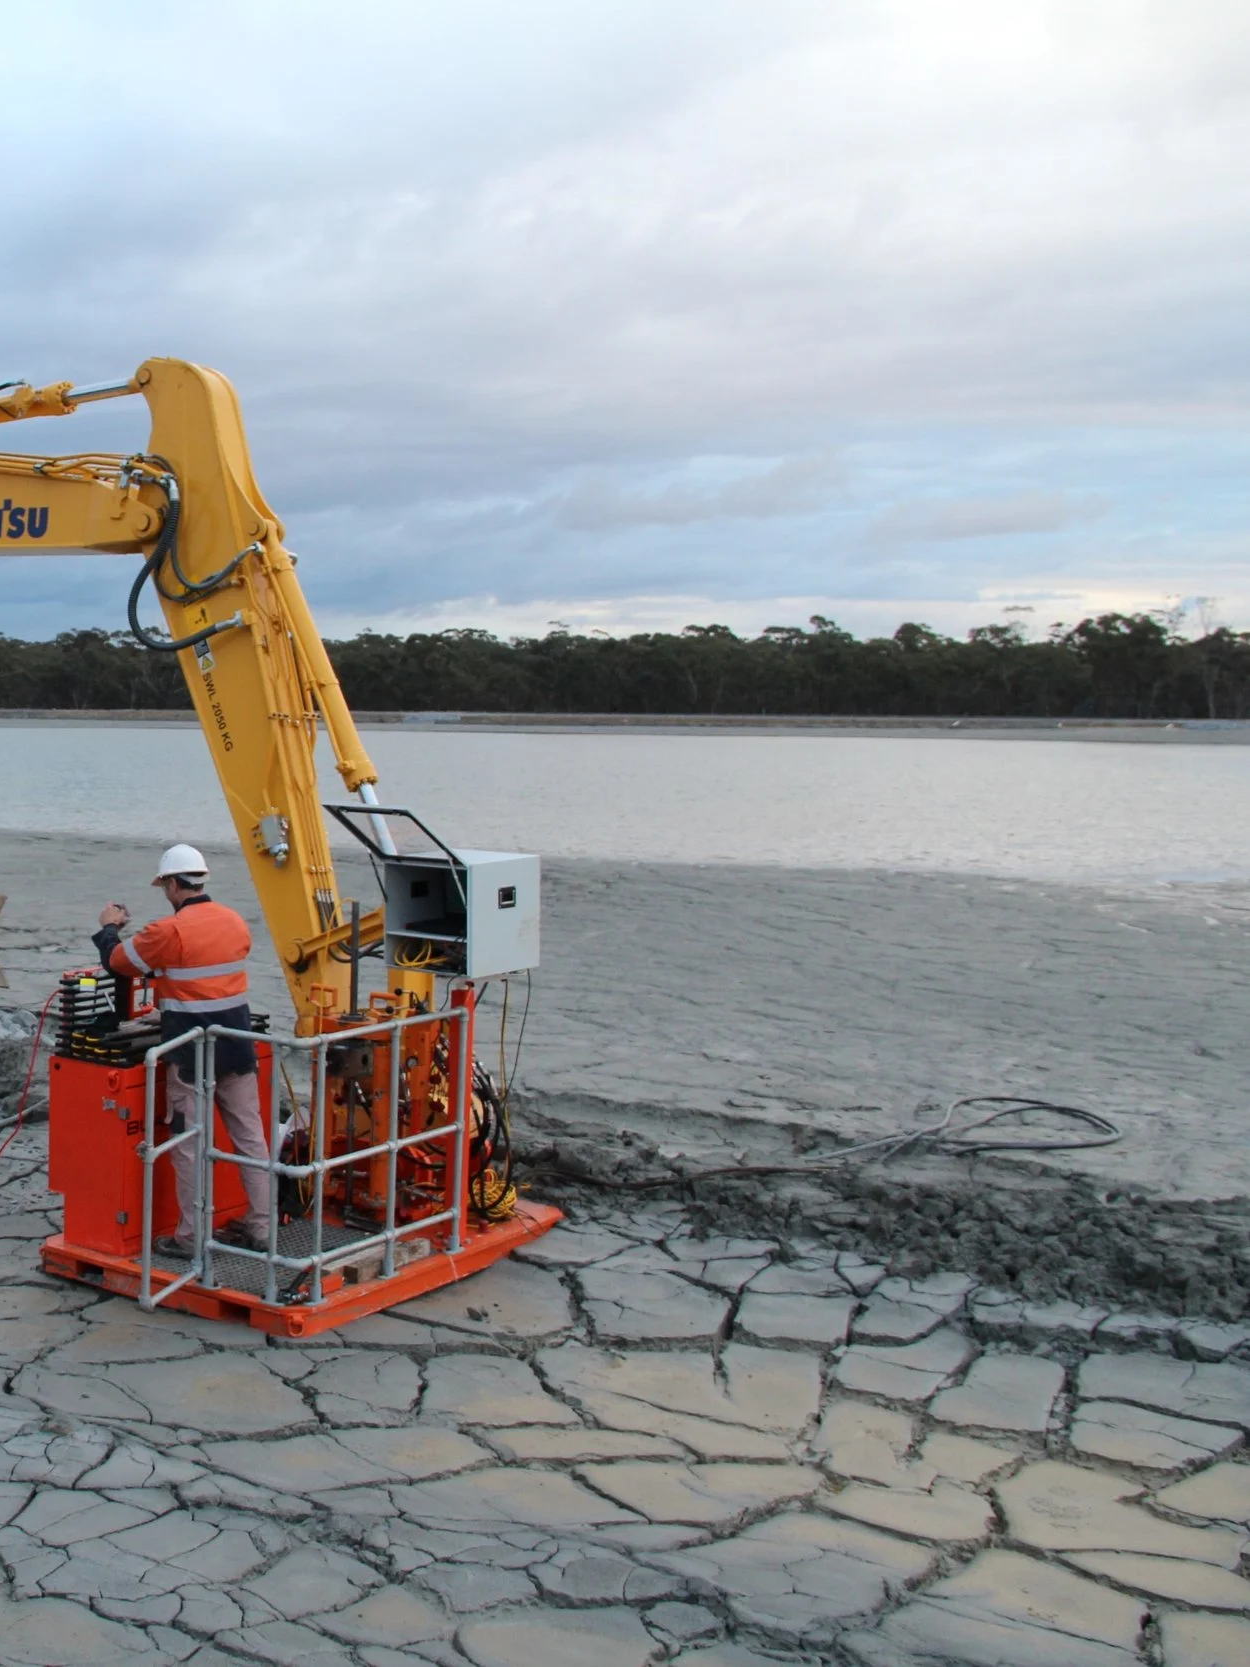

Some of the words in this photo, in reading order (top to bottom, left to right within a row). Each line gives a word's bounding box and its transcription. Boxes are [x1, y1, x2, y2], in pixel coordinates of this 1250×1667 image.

[202, 672, 216, 700] SWL
[212, 702, 226, 730] 2050
[221, 731, 233, 752] KG
